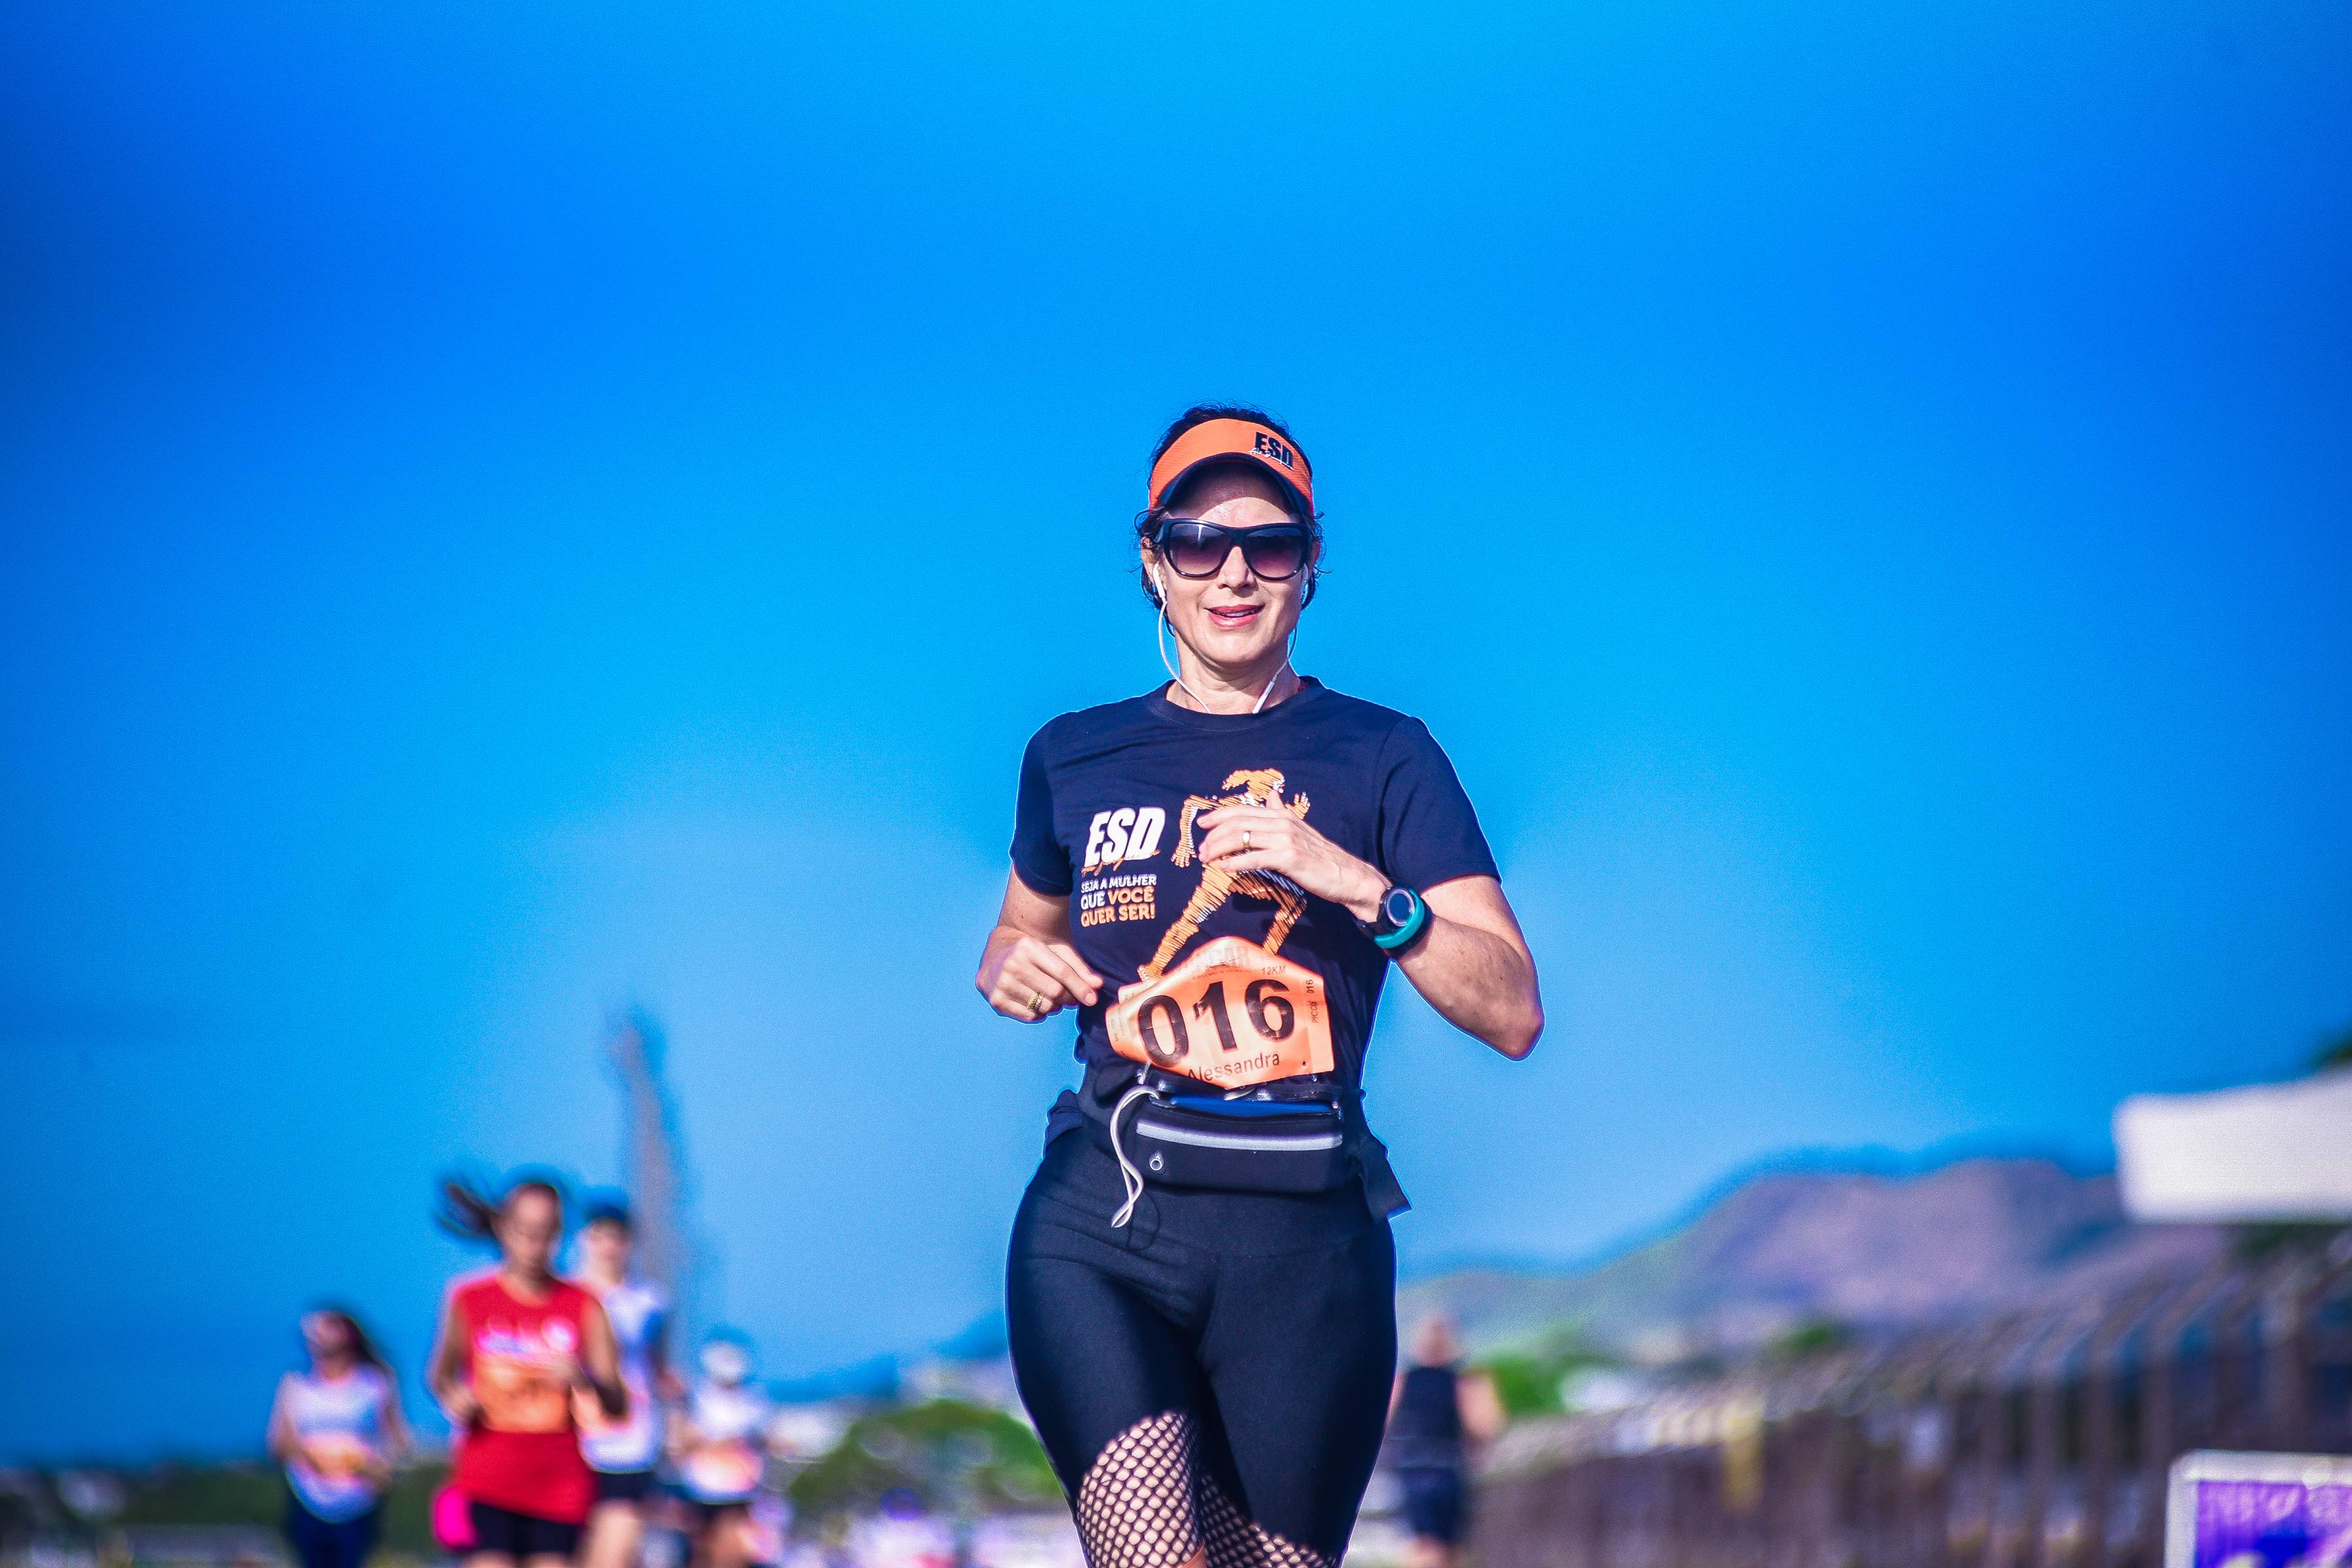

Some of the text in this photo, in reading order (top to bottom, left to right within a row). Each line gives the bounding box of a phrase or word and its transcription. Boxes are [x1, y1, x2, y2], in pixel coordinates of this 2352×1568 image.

[1255, 432, 1293, 467] ESD
[1085, 807, 1166, 868] ESD
[1081, 874, 1156, 893] SEJA A MULHER
[1081, 890, 1105, 910] QUE
[1081, 902, 1156, 927] QUER SER!
[1262, 966, 1286, 975] 12KM
[1306, 979, 1315, 994] 016
[1138, 979, 1295, 1068] 016
[1188, 1053, 1280, 1081] Alessandra
